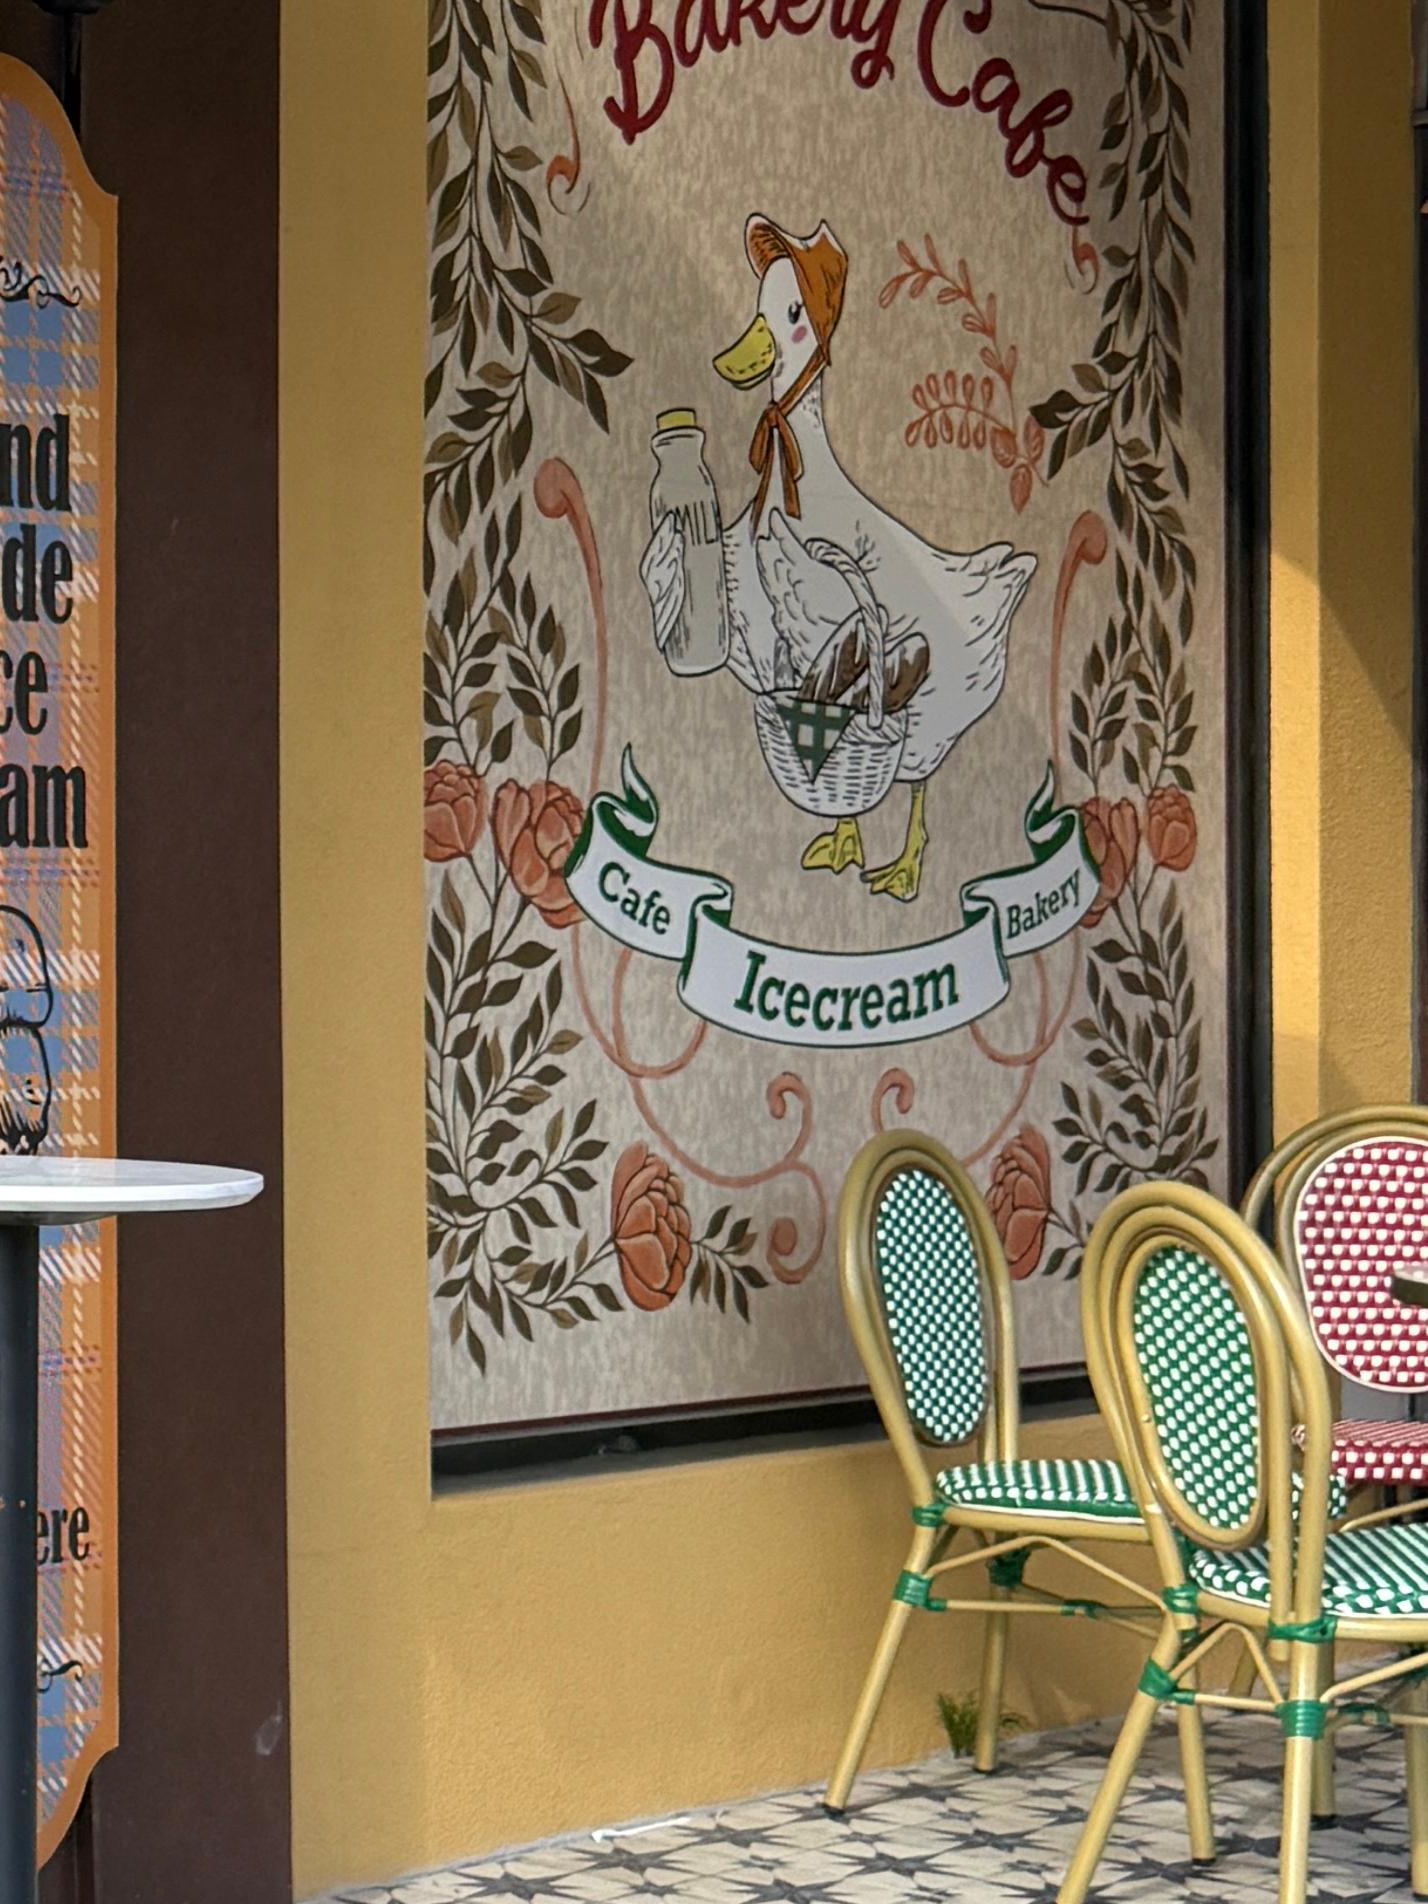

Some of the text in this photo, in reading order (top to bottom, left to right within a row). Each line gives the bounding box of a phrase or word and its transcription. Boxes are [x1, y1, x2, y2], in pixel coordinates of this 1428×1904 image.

[598, 861, 672, 935] Cafe
[1006, 868, 1081, 940] Bakery
[734, 951, 959, 1032] Icecream
